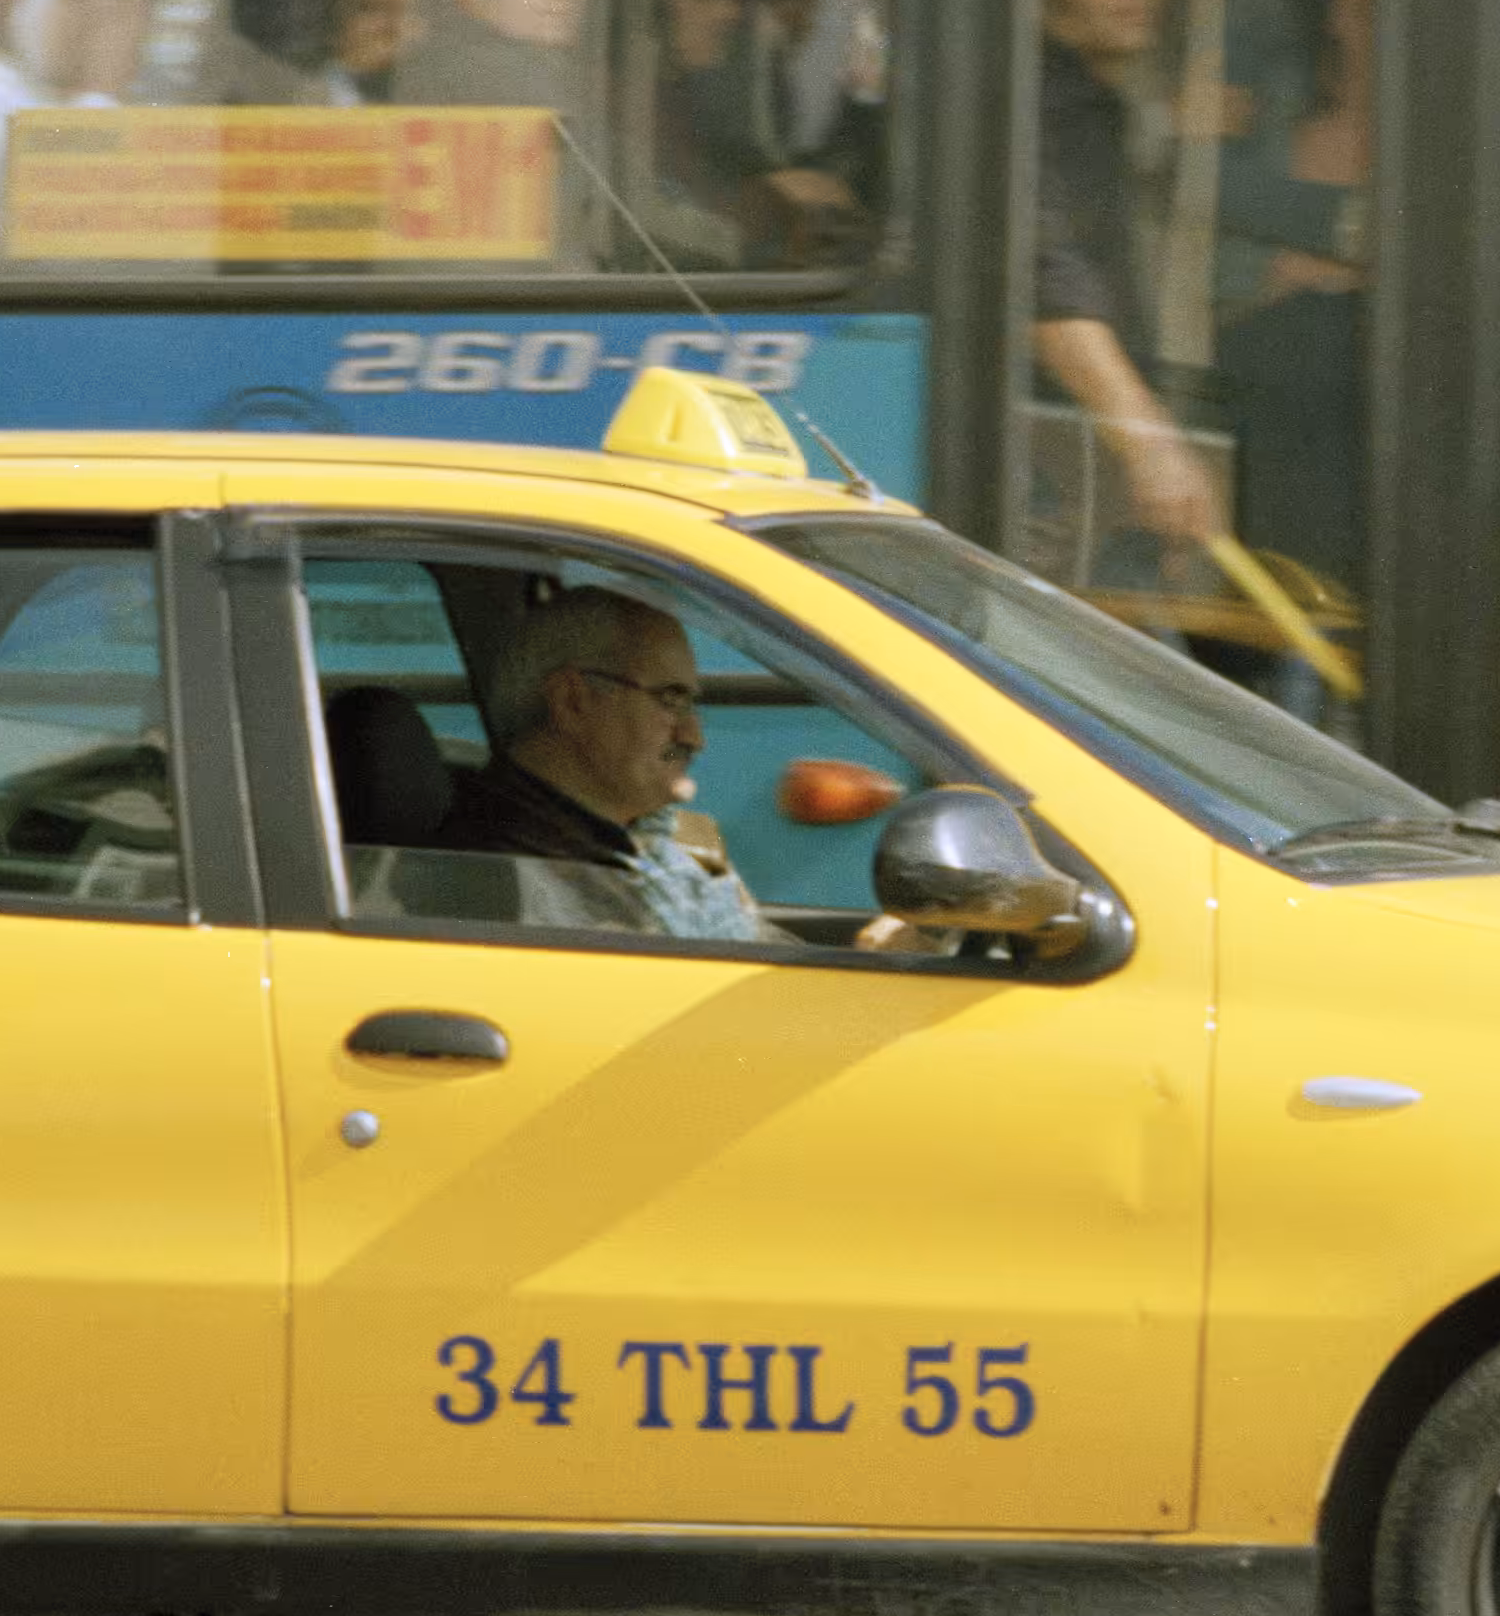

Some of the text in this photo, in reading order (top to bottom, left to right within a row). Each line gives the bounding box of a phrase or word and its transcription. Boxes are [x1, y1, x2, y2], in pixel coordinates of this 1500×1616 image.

[434, 1334, 1037, 1438] 34 THL 55
